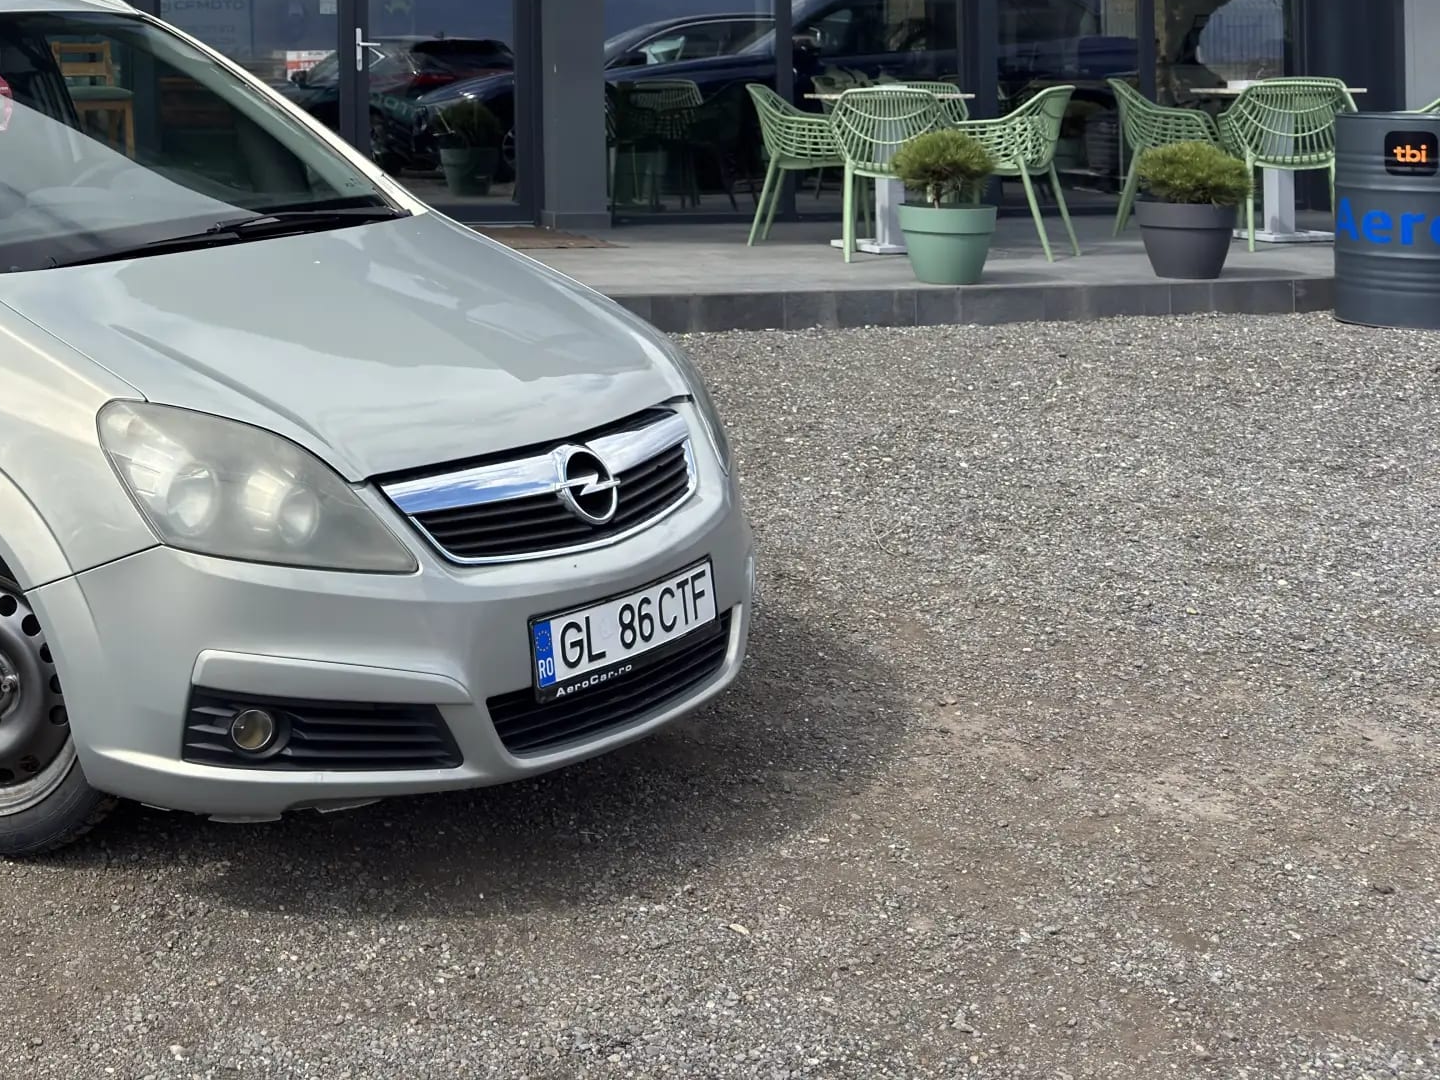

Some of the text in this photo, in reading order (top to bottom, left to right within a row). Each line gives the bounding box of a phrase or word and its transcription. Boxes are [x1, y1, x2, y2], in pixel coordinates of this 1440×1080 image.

[1393, 144, 1427, 163] tbi
[560, 615, 607, 669] GL
[538, 657, 555, 681] RO
[555, 663, 633, 698] AeroCar.ro
